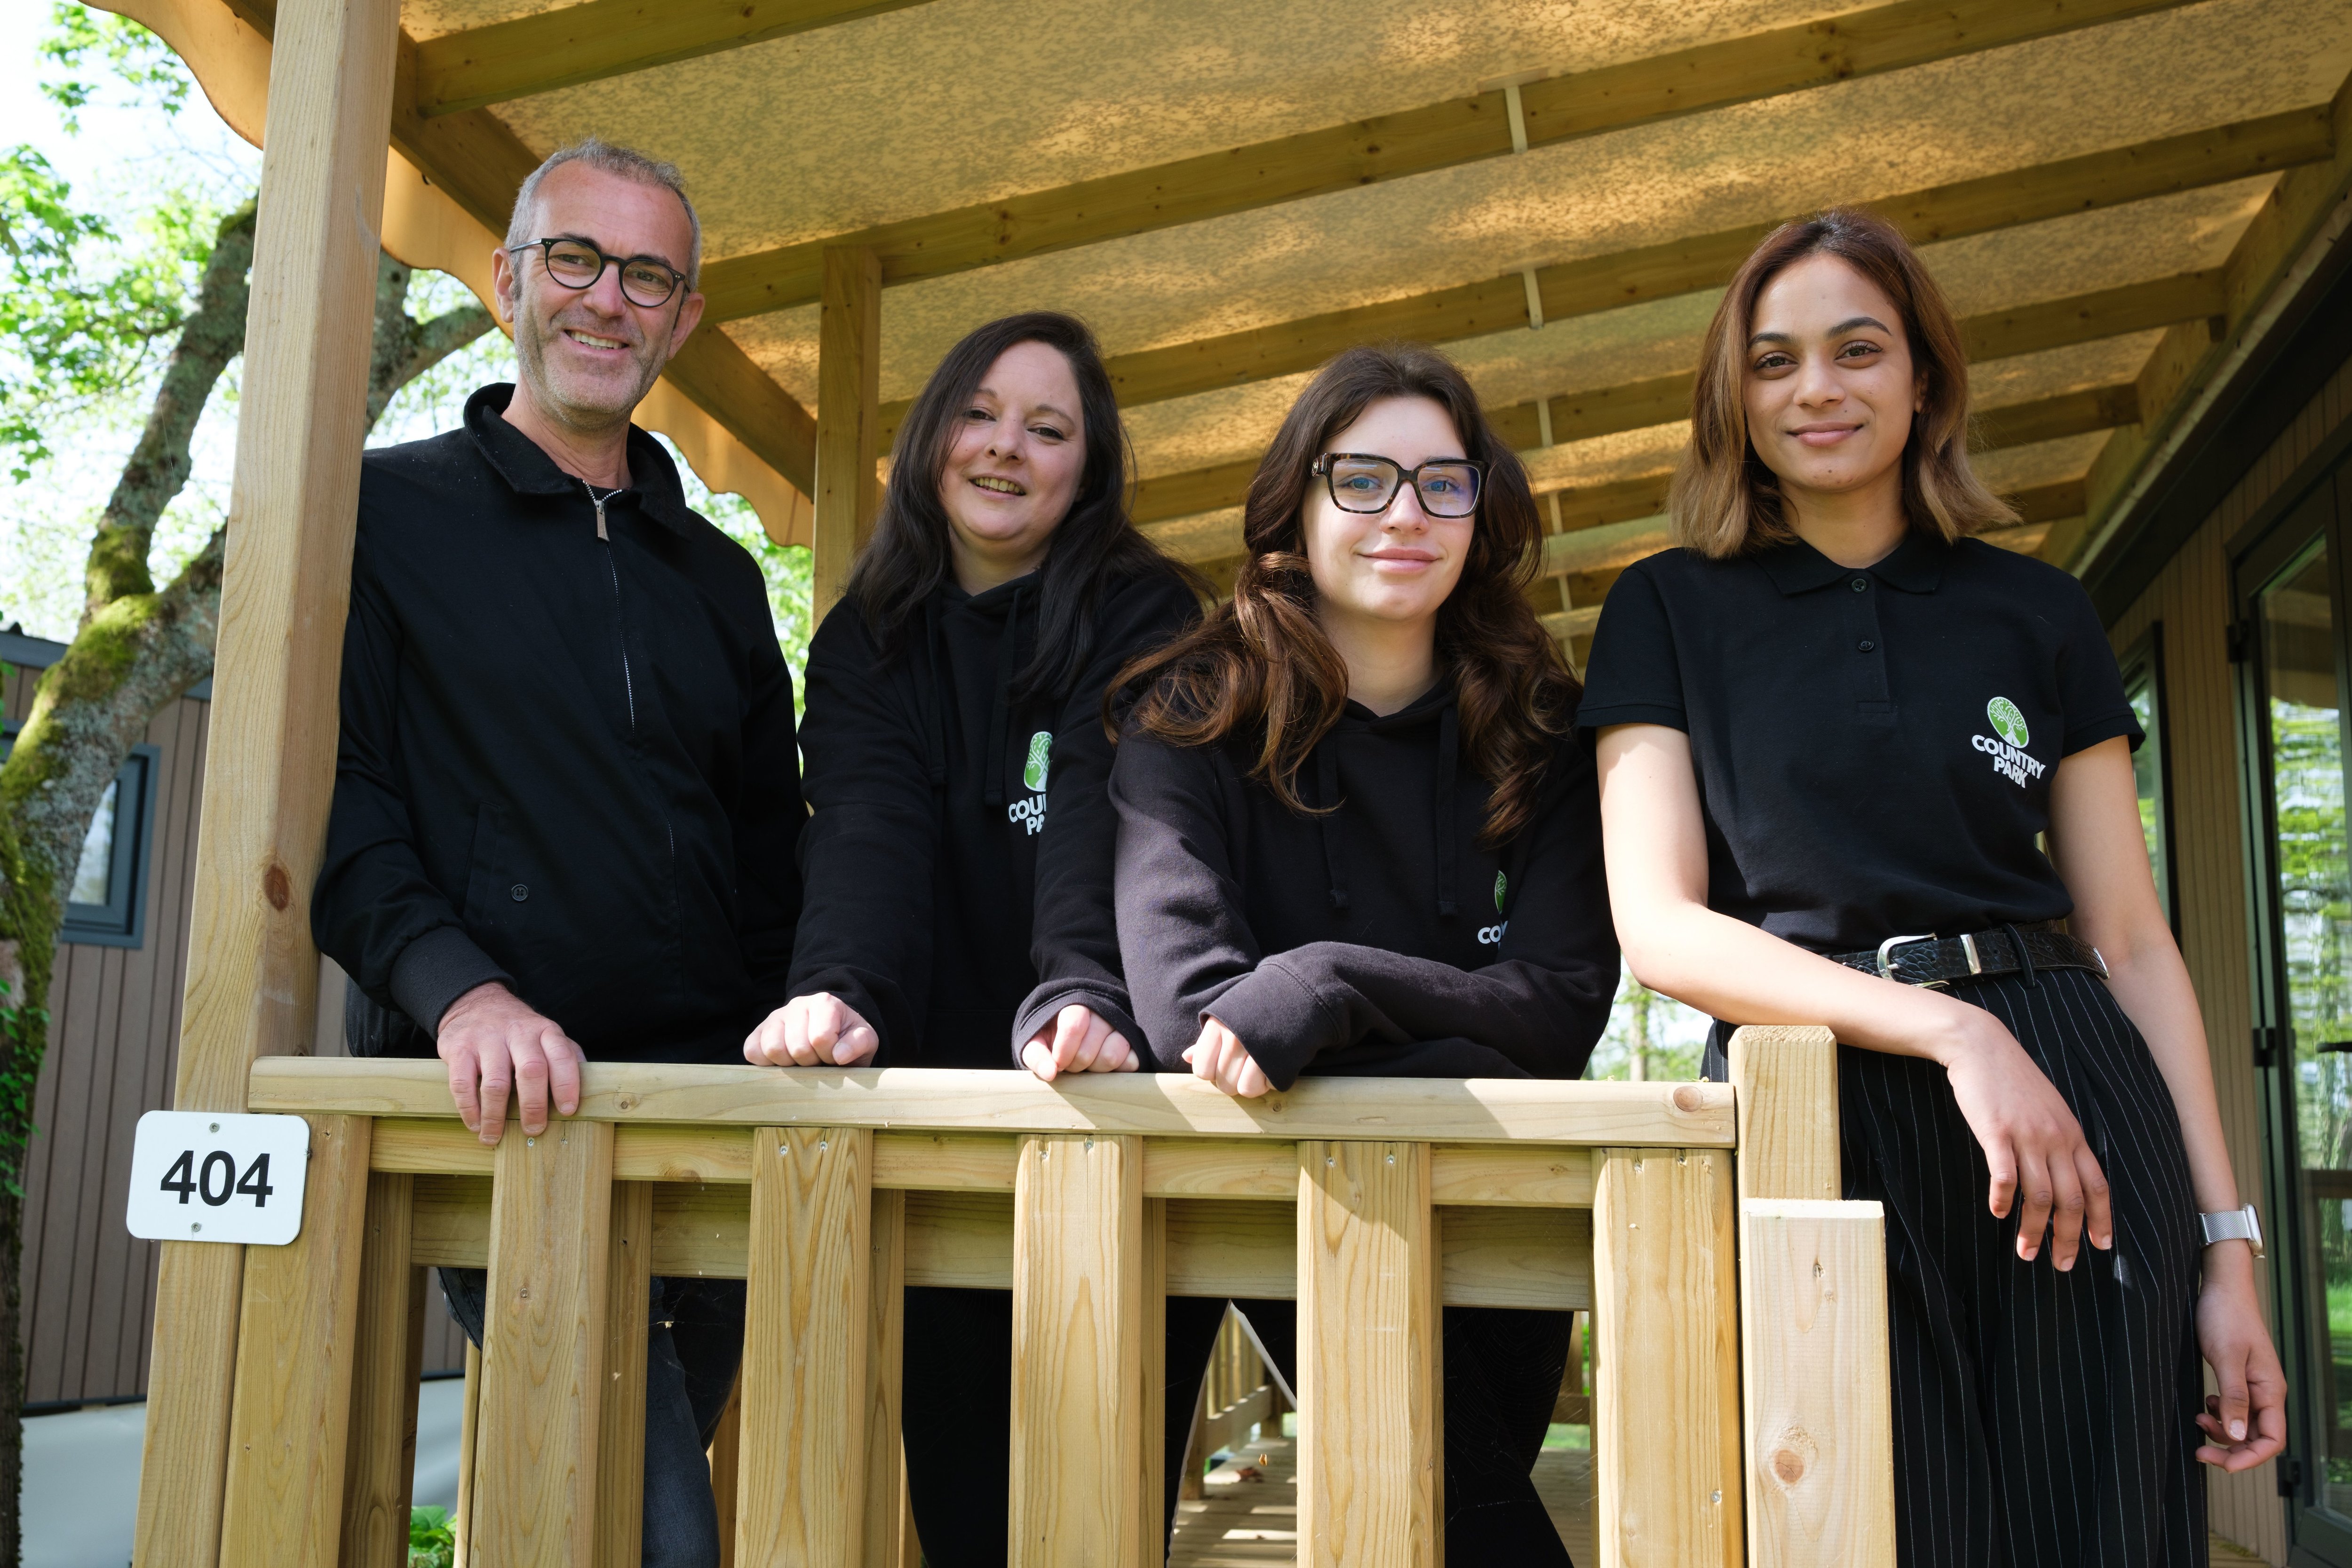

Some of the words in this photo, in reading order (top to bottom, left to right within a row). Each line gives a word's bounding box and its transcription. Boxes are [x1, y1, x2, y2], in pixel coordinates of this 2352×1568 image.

[1972, 735, 2046, 779] COUNTRY
[1994, 756, 2028, 788] PARK
[160, 1150, 274, 1208] 404
